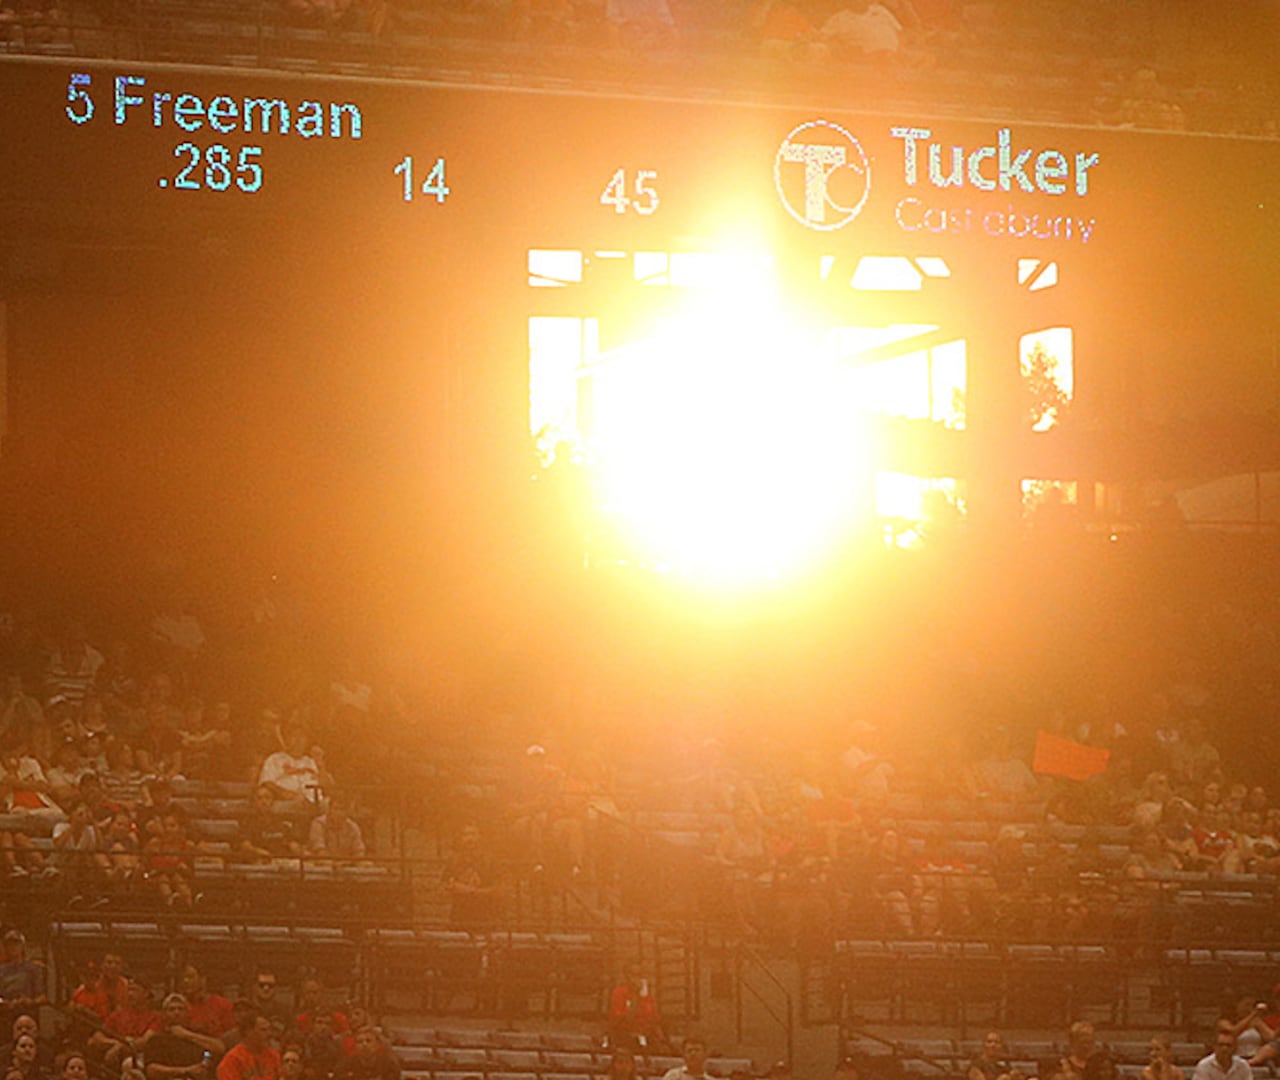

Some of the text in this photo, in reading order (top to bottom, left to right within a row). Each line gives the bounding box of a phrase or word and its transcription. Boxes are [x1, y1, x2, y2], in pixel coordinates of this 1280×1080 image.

[64, 73, 364, 139] 5 Freeman
[158, 143, 660, 214] .285 14 45
[890, 127, 1100, 196] Tucker
